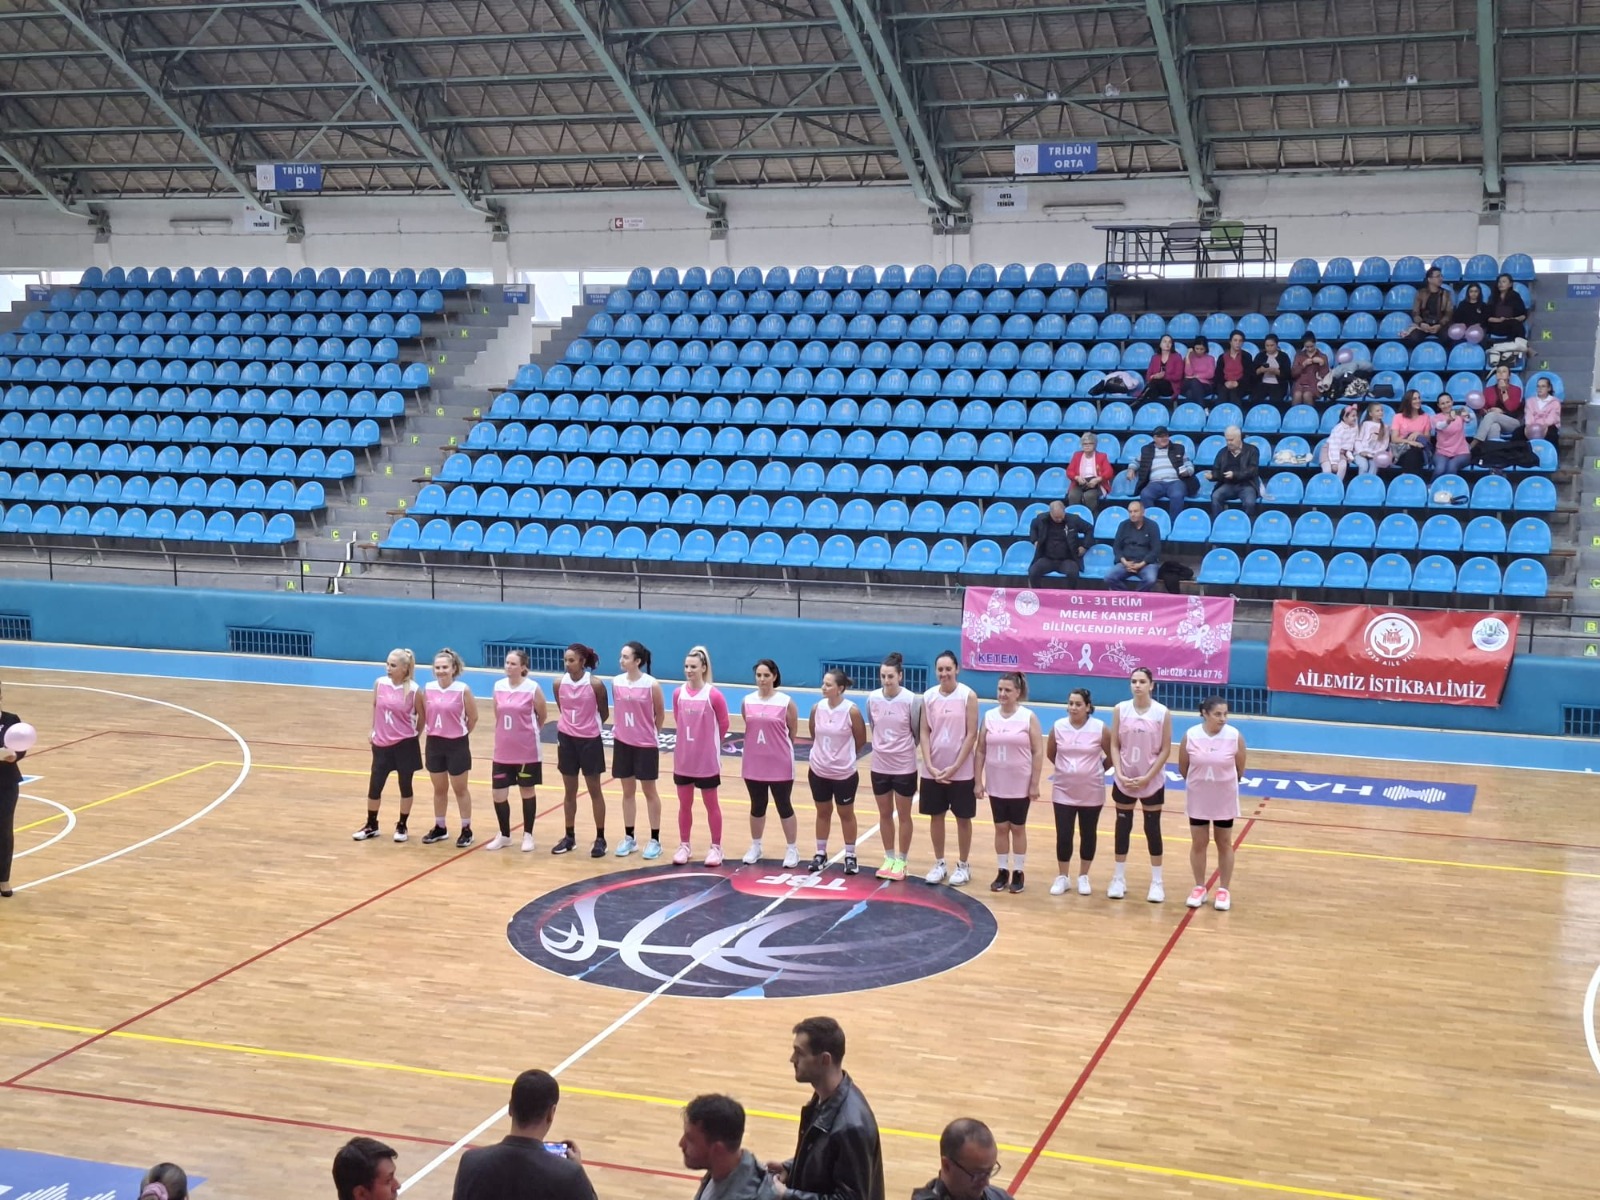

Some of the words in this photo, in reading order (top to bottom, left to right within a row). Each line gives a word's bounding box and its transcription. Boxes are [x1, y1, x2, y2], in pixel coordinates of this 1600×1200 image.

[1048, 144, 1091, 156] TRİBÜN
[282, 164, 317, 175] TRİBÜN
[1054, 159, 1084, 168] ORTA
[295, 176, 305, 189] B
[1070, 595, 1084, 605] 01
[1094, 596, 1107, 606] 31
[1111, 595, 1142, 607] EKİM
[1060, 609, 1097, 620] MEME
[1101, 610, 1153, 622] KANSERİ
[1042, 621, 1144, 636] BİLİNÇLENDİRME
[1147, 626, 1167, 636] AYI
[978, 653, 1018, 664] KETEM
[1156, 667, 1169, 676] Tel:
[1189, 668, 1202, 678] 214
[1203, 669, 1212, 678] 87
[1214, 670, 1223, 679] 76
[1295, 669, 1365, 691] AİLEMİZ
[1369, 674, 1486, 699] İSTİKBALİMİZ
[384, 710, 394, 725] K
[434, 714, 443, 729] A
[503, 714, 512, 730] D
[571, 709, 576, 724] I
[624, 712, 635, 728] N
[686, 726, 694, 742] L
[756, 729, 767, 745] A
[883, 728, 896, 743] S
[940, 726, 950, 743] A
[822, 735, 832, 751] R
[996, 745, 1007, 762] H
[1130, 746, 1141, 763] D
[1067, 758, 1078, 773] A
[1204, 765, 1215, 782] A
[755, 872, 848, 891] TBF
